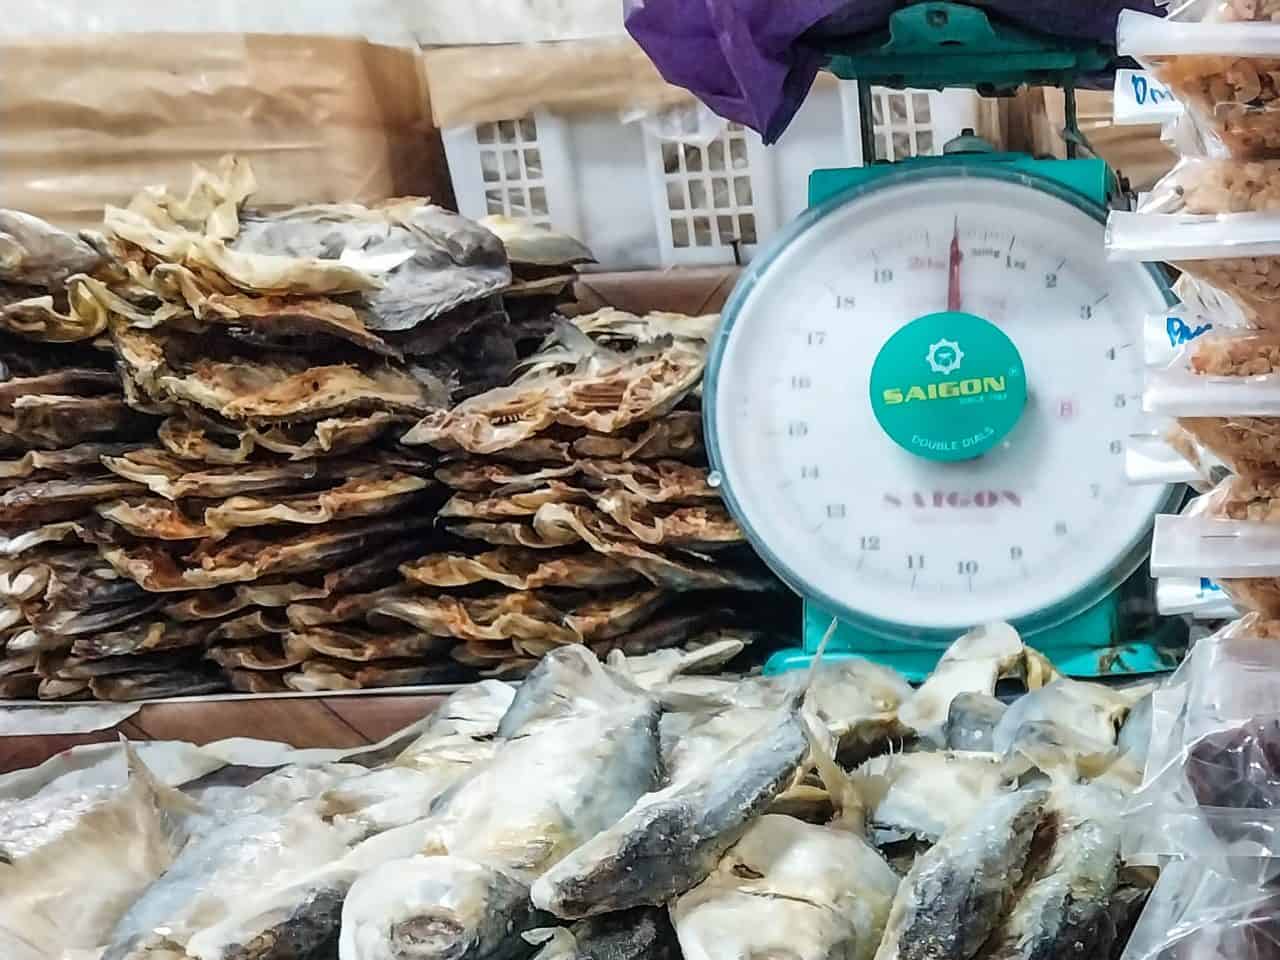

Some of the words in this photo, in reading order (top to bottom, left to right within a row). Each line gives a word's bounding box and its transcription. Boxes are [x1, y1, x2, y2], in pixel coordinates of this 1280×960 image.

[1045, 272, 1058, 289] 2
[882, 375, 1007, 405] SAIGON
[911, 433, 959, 451] DOUBLE
[961, 425, 995, 449] DIALS
